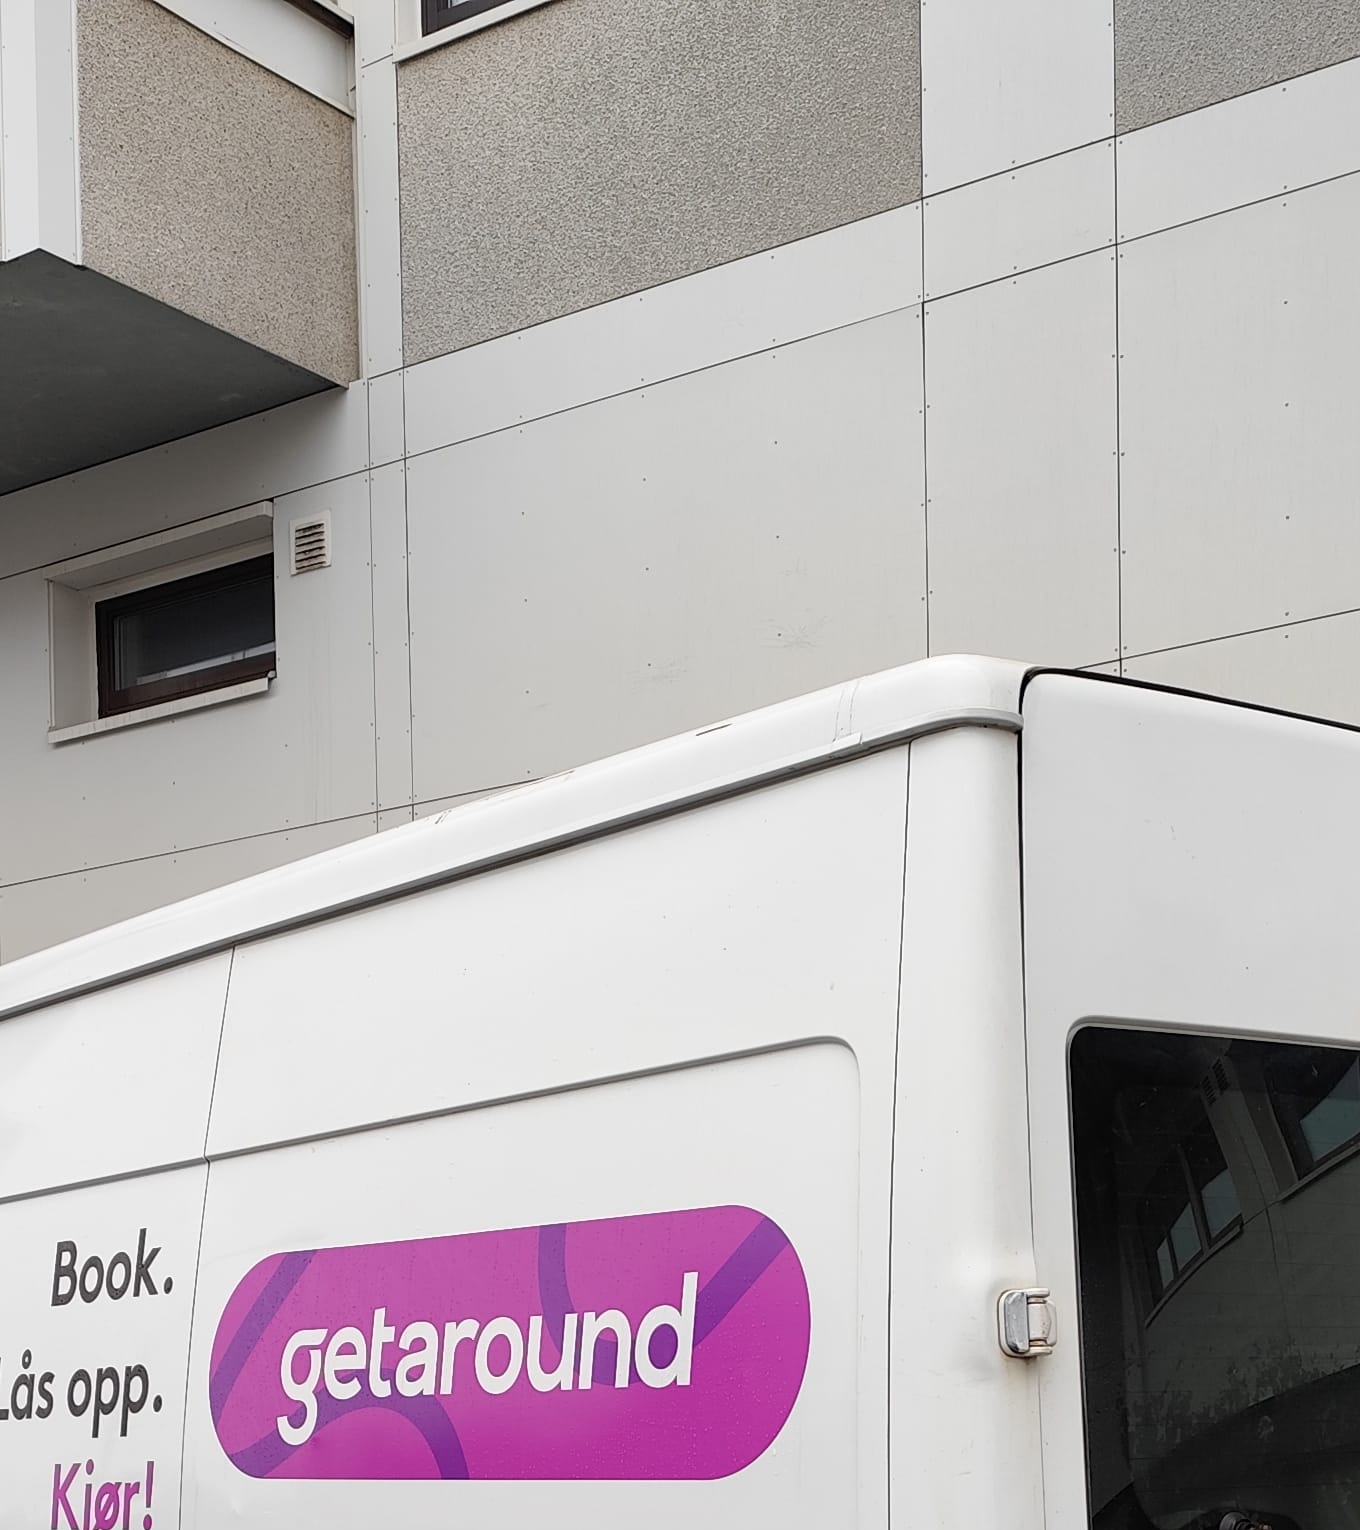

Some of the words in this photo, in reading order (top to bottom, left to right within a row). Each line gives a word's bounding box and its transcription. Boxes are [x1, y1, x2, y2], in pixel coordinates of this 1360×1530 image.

[51, 1228, 173, 1307] Book.
[276, 1271, 699, 1446] getaround
[67, 1361, 163, 1438] opp.
